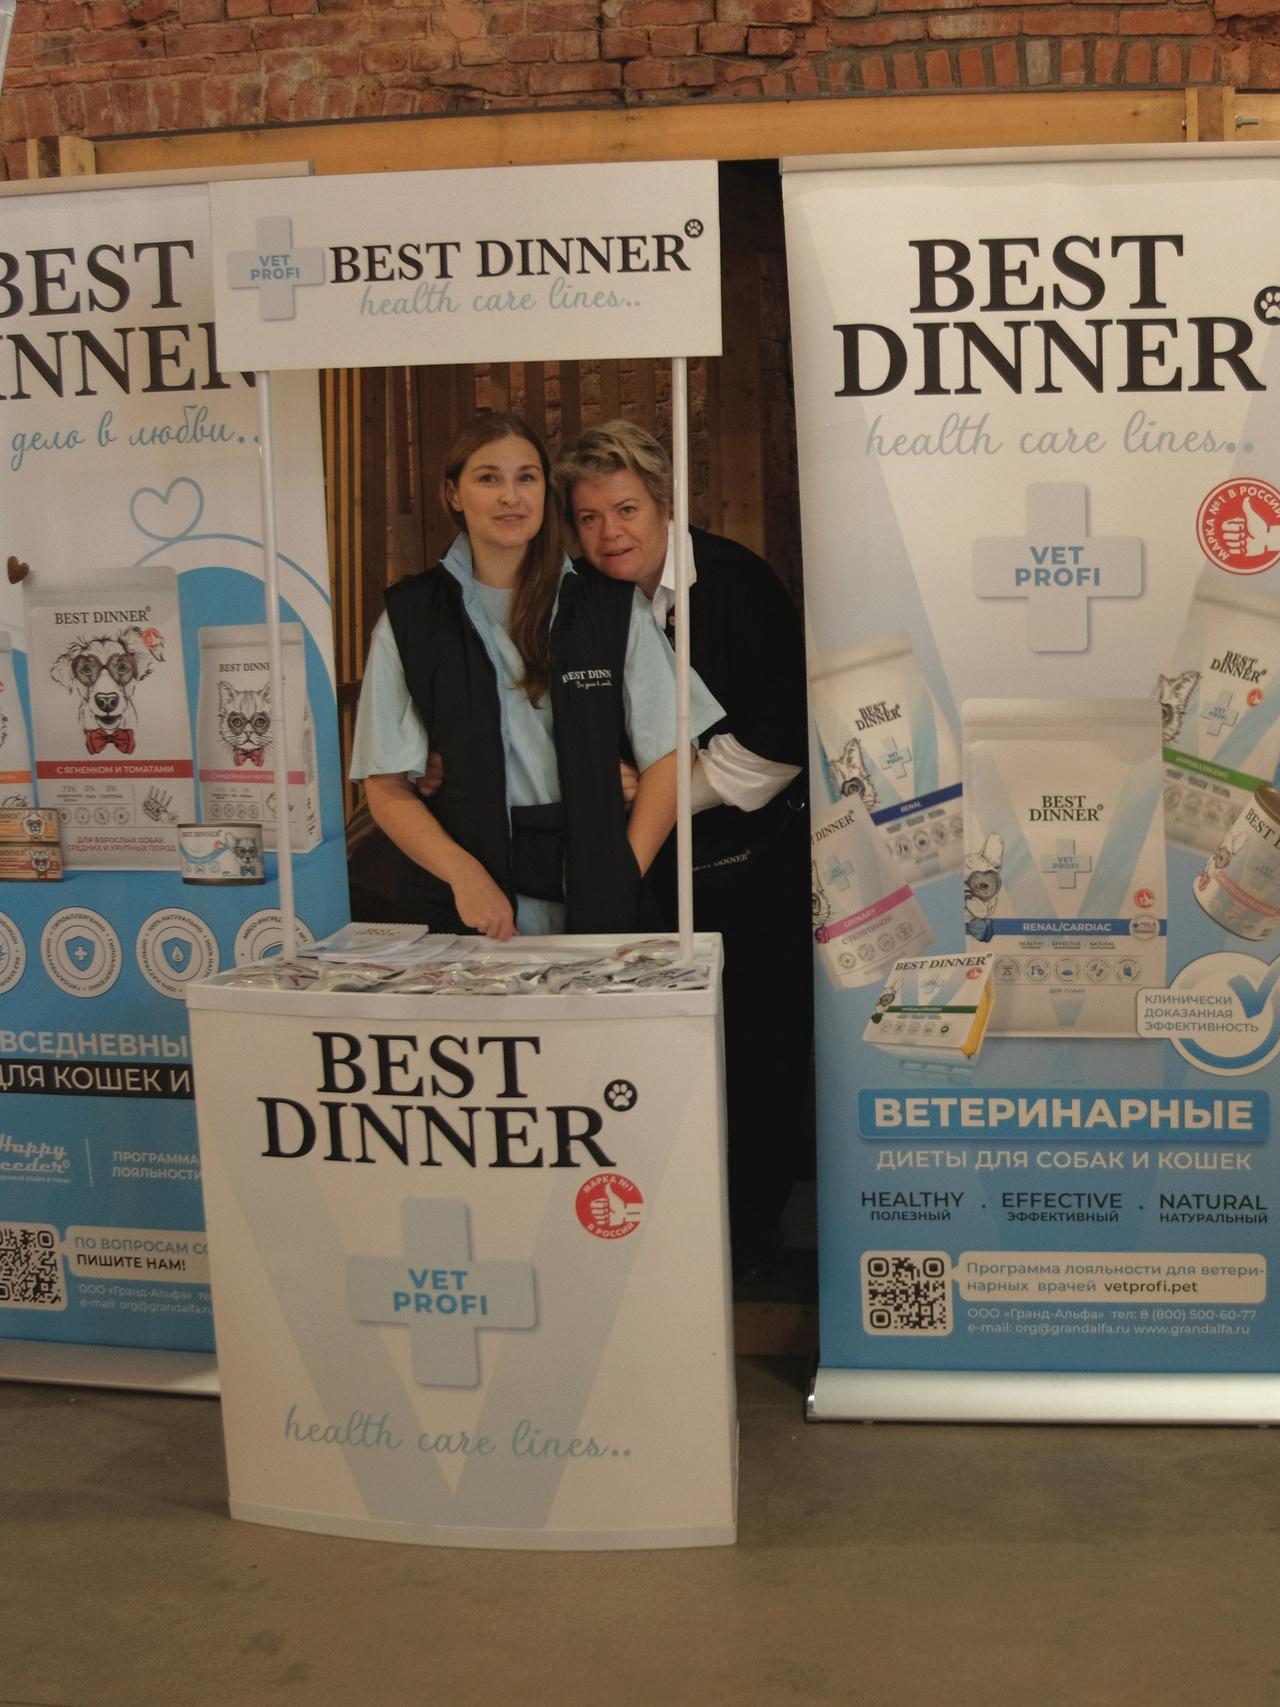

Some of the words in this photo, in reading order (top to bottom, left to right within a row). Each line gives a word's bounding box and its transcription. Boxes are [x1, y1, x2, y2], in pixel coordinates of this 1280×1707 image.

[259, 255, 291, 267] VET
[329, 243, 460, 283] BEST
[476, 234, 691, 277] DINNER
[251, 268, 300, 281] PROFI
[909, 235, 1183, 314] BEST
[360, 281, 460, 316] health
[473, 289, 536, 312] care
[833, 316, 1266, 397] DINNER
[11, 431, 85, 471] дело
[98, 410, 117, 446] в
[866, 413, 1002, 457] health
[1019, 425, 1105, 454] care
[1227, 489, 1236, 499] В
[1208, 495, 1226, 515] №1
[1205, 518, 1230, 561] МАРКА
[1030, 545, 1084, 565] VET
[1014, 567, 1101, 586] PROFI
[55, 611, 90, 625] BEST
[93, 610, 148, 624] DINNER
[855, 709, 901, 731] DINNER
[900, 800, 922, 813] RENAL
[1041, 795, 1086, 809] BEST
[1029, 808, 1099, 821] DINNER
[816, 814, 855, 842] DINNER
[1023, 922, 1112, 933] RENAL/CARDIAC
[895, 961, 927, 971] BEST
[929, 957, 987, 968] DINNER
[1144, 994, 1232, 1006] КЛИНИЧЕСКИ
[1144, 1008, 1233, 1019] ДОКАЗАННАЯ
[1144, 1021, 1258, 1032] ЭФФЕКТИВНОСТЬ
[313, 1030, 540, 1099] BEST
[55, 1066, 162, 1092] КОШЕК
[170, 1070, 191, 1093] И
[874, 1097, 1253, 1130] ВЕТЕРИНАРНЫЕ
[257, 1096, 617, 1168] DINNER
[113, 1151, 199, 1164] ПРОГРАММА
[876, 1150, 968, 1171] ДИЕТЫ
[974, 1150, 1030, 1171] ДЛЯ
[1036, 1151, 1125, 1169] СОБАК
[1130, 1152, 1150, 1169] И
[1158, 1152, 1252, 1171] КОШЕК
[860, 1191, 965, 1208] HEALTHY
[1002, 1192, 1122, 1209] EFFECTIVE
[1159, 1193, 1268, 1210] NATURAL
[870, 1210, 951, 1221] ПОЛЕЗНЫЙ
[1006, 1210, 1119, 1222] ЭФФЕКТИВНЫЙ
[1159, 1212, 1268, 1224] НАТУРАЛЬНЫЙ
[595, 1222, 635, 1238] РОССИИ
[74, 1237, 96, 1249] ПО
[101, 1238, 189, 1254] ВОПРОСАМ
[77, 1254, 143, 1269] ПИШИТЕ
[147, 1257, 186, 1271] НАМ!
[967, 1262, 1061, 1277] Программа
[1064, 1265, 1162, 1276] лояльности
[1165, 1265, 1197, 1278] для
[1200, 1266, 1266, 1277] ветери-
[408, 1268, 469, 1291] VET
[967, 1280, 1029, 1293] нарных
[1038, 1279, 1097, 1293] врачей
[1104, 1279, 1198, 1294] vetprofi.pet
[393, 1291, 488, 1317] PROFI
[967, 1307, 1001, 1319] ООО
[1003, 1307, 1105, 1322] «Гранд-Альфа»
[1111, 1310, 1138, 1320] тел:
[1140, 1309, 1148, 1320] 8
[1151, 1309, 1187, 1323] (800)
[1188, 1309, 1257, 1321] 500-60-77
[967, 1322, 1013, 1333] e-mail:
[1014, 1323, 1130, 1336] org@grandalfa.ru
[1133, 1324, 1250, 1336] www.grandalfa.ru
[284, 1404, 403, 1451] health
[417, 1432, 498, 1456] care
